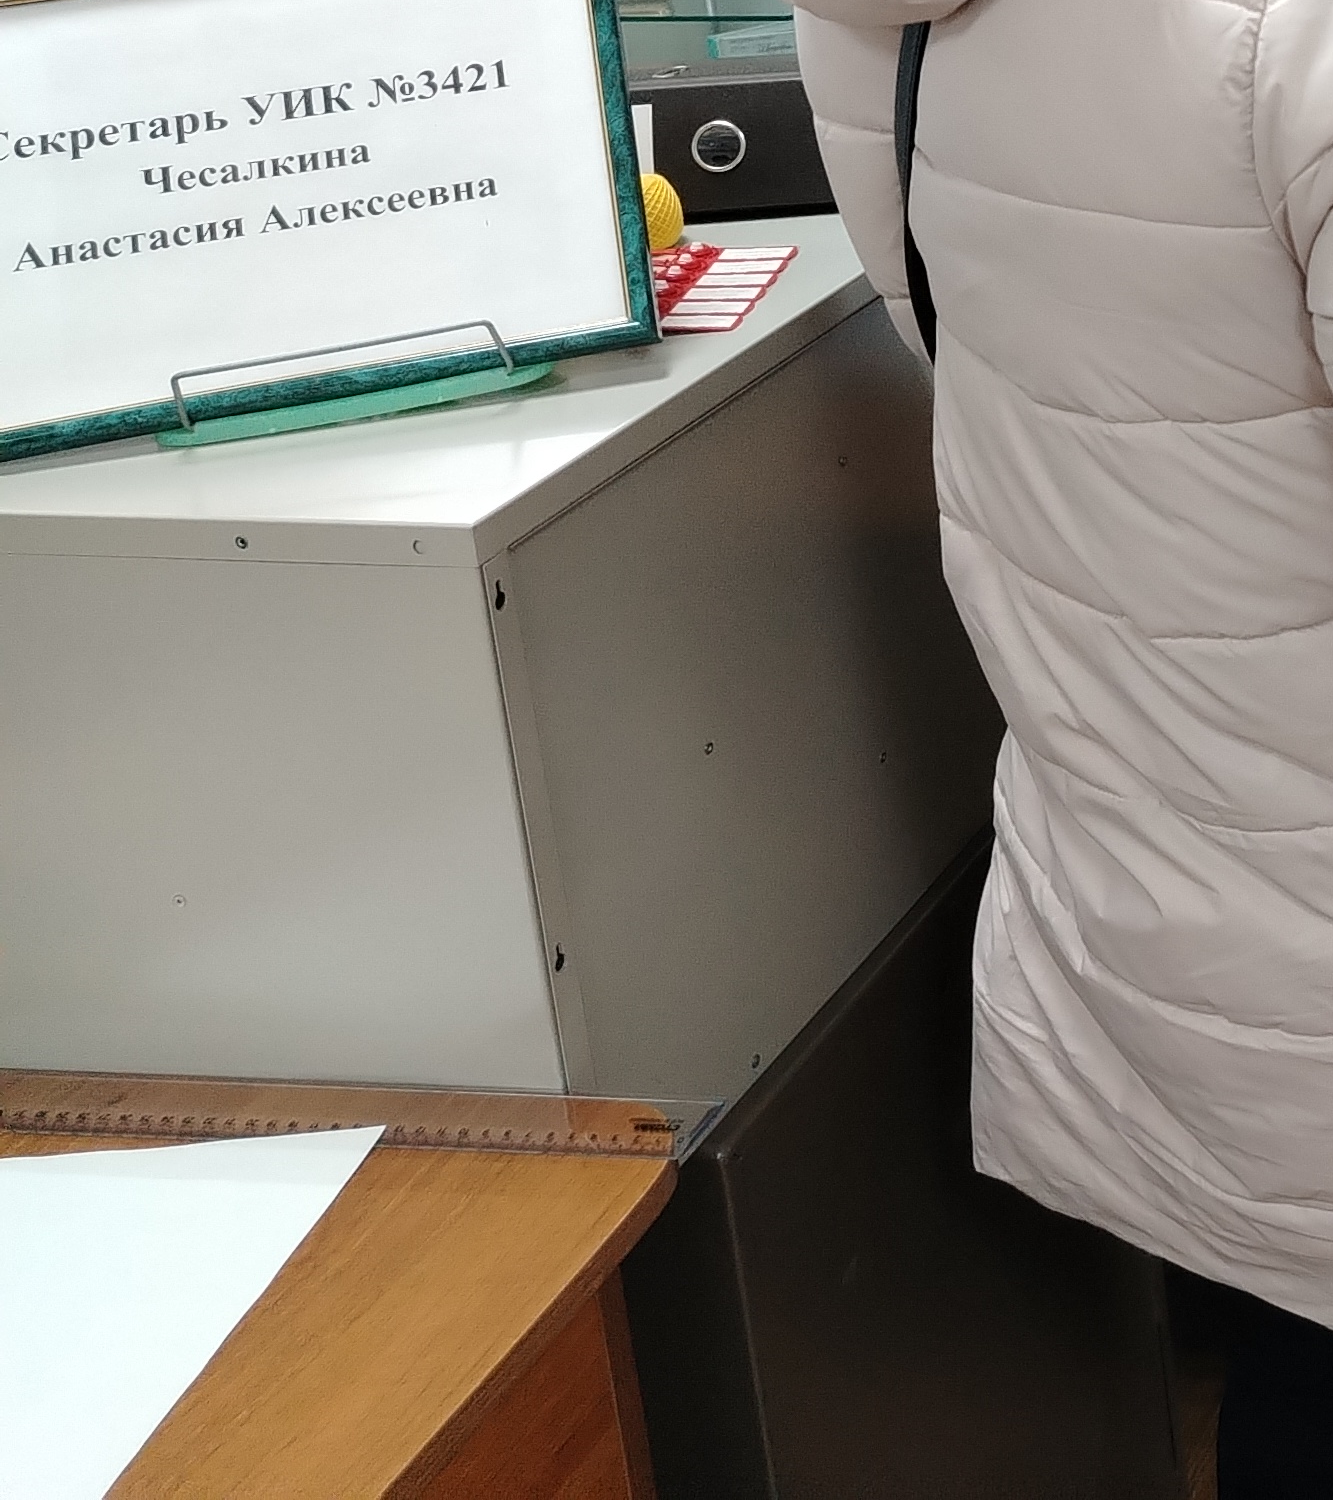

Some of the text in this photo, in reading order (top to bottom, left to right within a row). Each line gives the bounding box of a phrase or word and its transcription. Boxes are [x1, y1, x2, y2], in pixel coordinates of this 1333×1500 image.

[241, 82, 355, 126] УИК
[367, 59, 511, 108] №3421
[140, 143, 371, 194] Чесалкина
[13, 176, 499, 273] Анастасия Алексеевна
